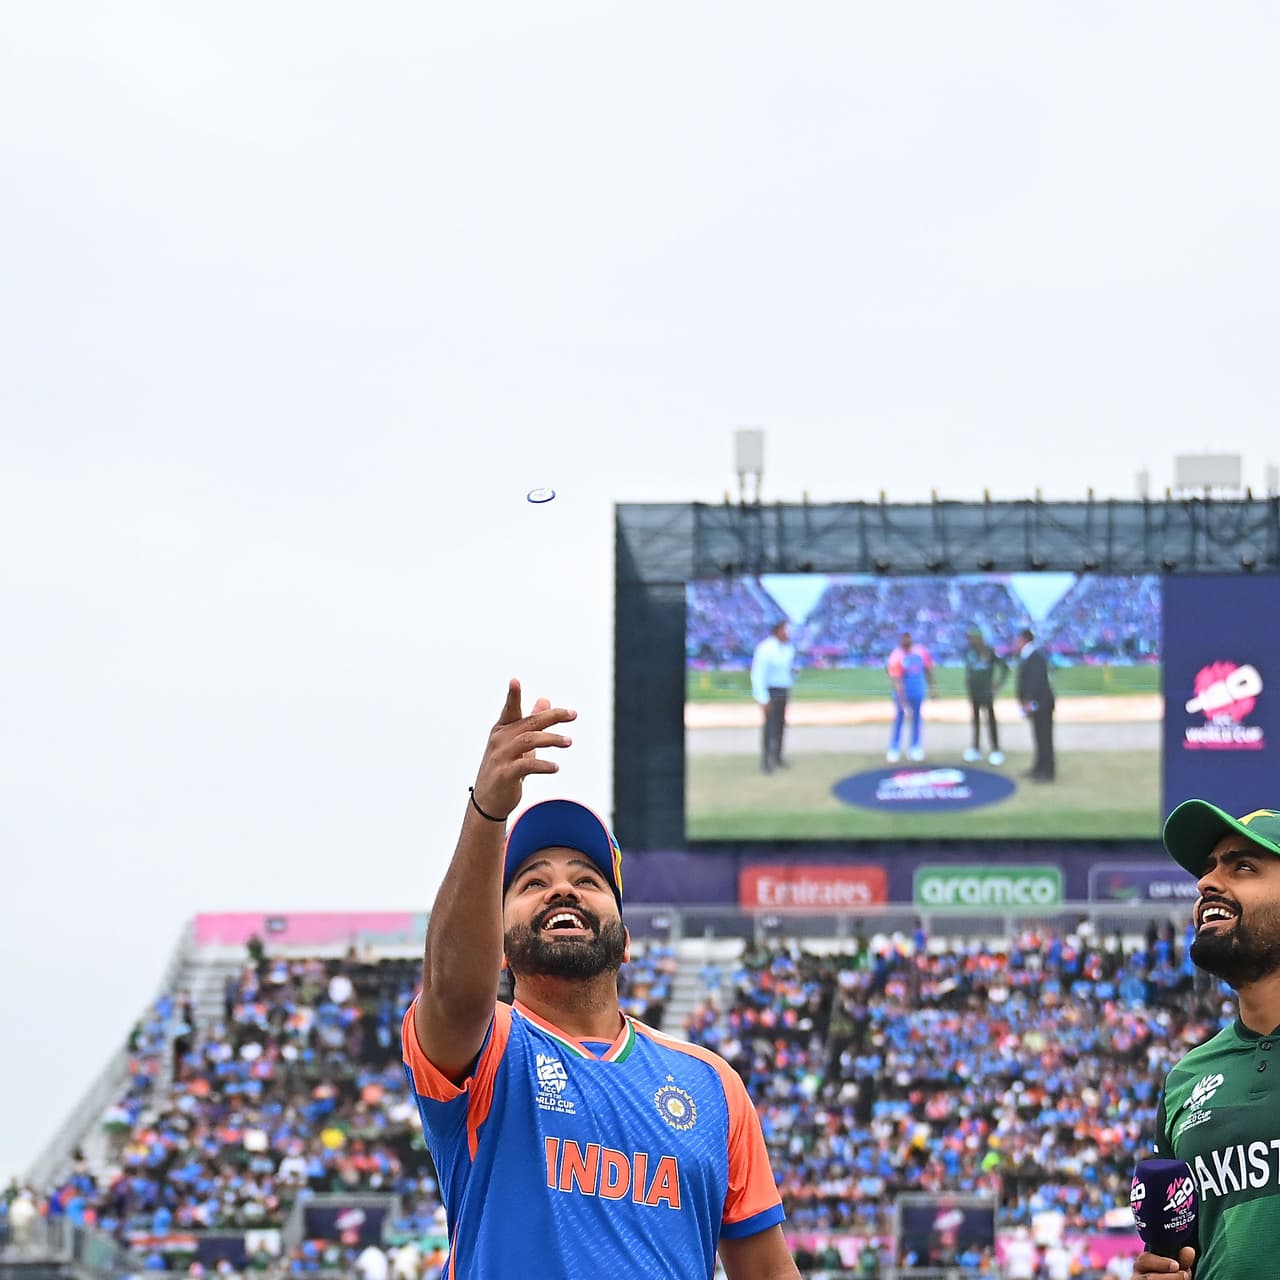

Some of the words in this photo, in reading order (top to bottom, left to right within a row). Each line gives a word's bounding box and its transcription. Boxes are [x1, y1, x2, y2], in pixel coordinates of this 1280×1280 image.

[1234, 726, 1264, 743] CUP
[756, 879, 870, 904] Emirates
[921, 877, 1058, 905] aramco
[544, 1086, 557, 1094] ICC
[557, 1099, 575, 1109] CUP
[544, 1136, 681, 1210] INDIA
[1163, 1176, 1195, 1211] T20
[1164, 1218, 1187, 1230] WORLD
